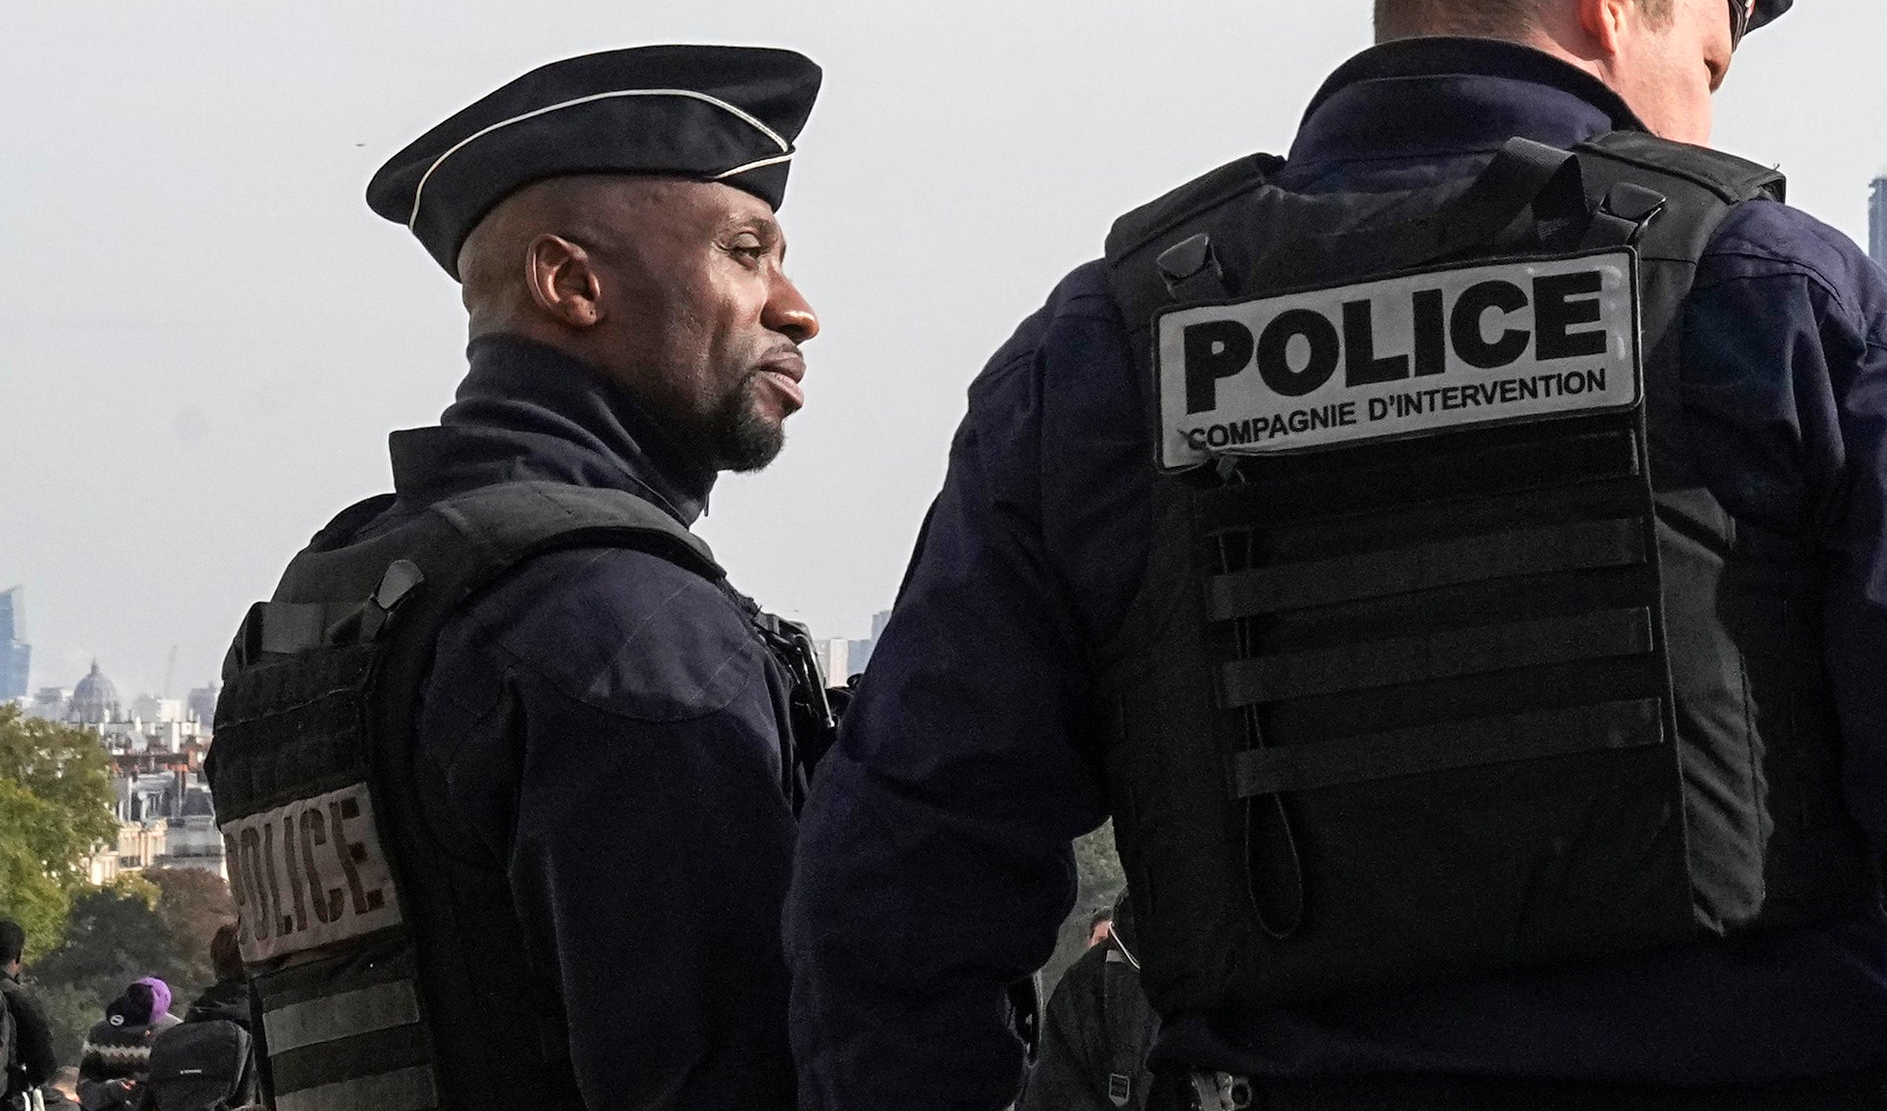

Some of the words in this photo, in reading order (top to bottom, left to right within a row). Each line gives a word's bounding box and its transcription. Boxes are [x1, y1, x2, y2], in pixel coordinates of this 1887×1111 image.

[1183, 270, 1608, 415] POLICE
[1183, 399, 1357, 451] COMPAGNIE
[1368, 367, 1607, 422] D'INTERVENTION
